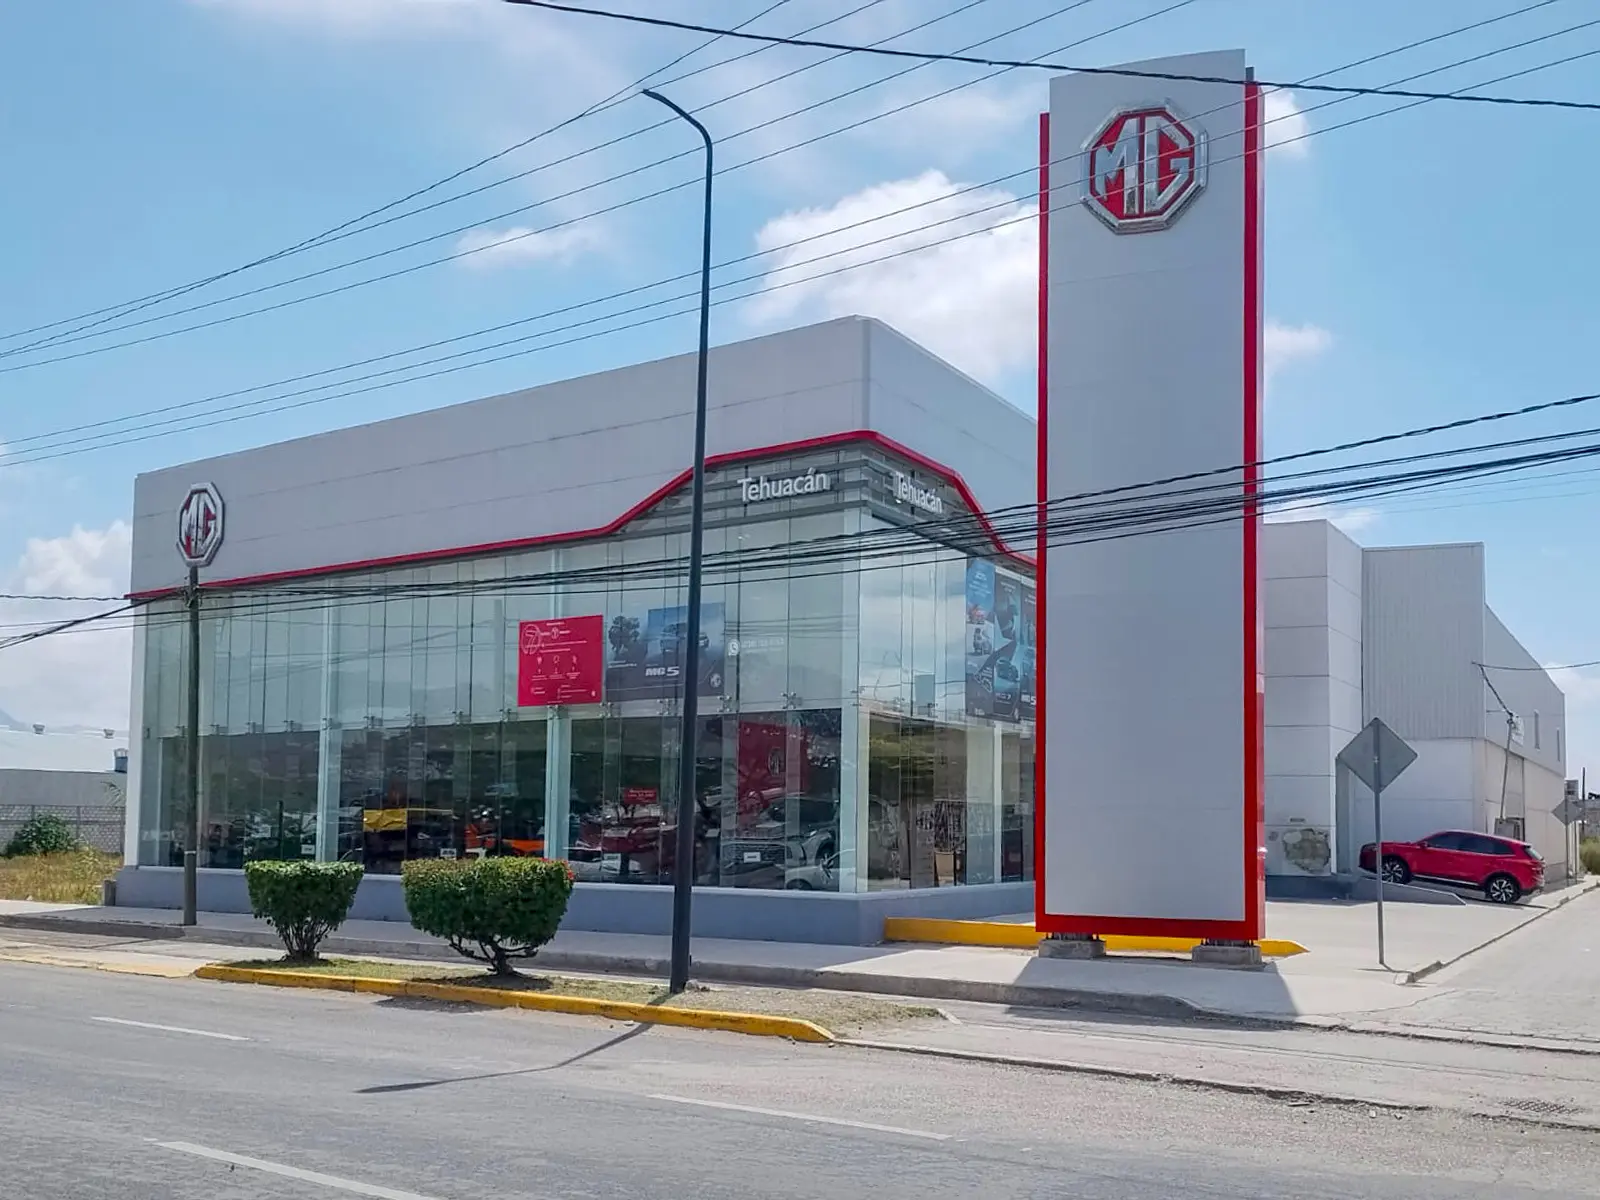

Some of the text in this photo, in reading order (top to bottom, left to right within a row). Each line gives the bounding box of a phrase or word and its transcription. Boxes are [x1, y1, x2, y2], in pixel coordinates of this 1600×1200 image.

[1095, 115, 1191, 215] MG
[737, 467, 832, 503] Tehuacán
[892, 471, 944, 514] Tehuacán
[181, 493, 217, 557] MG
